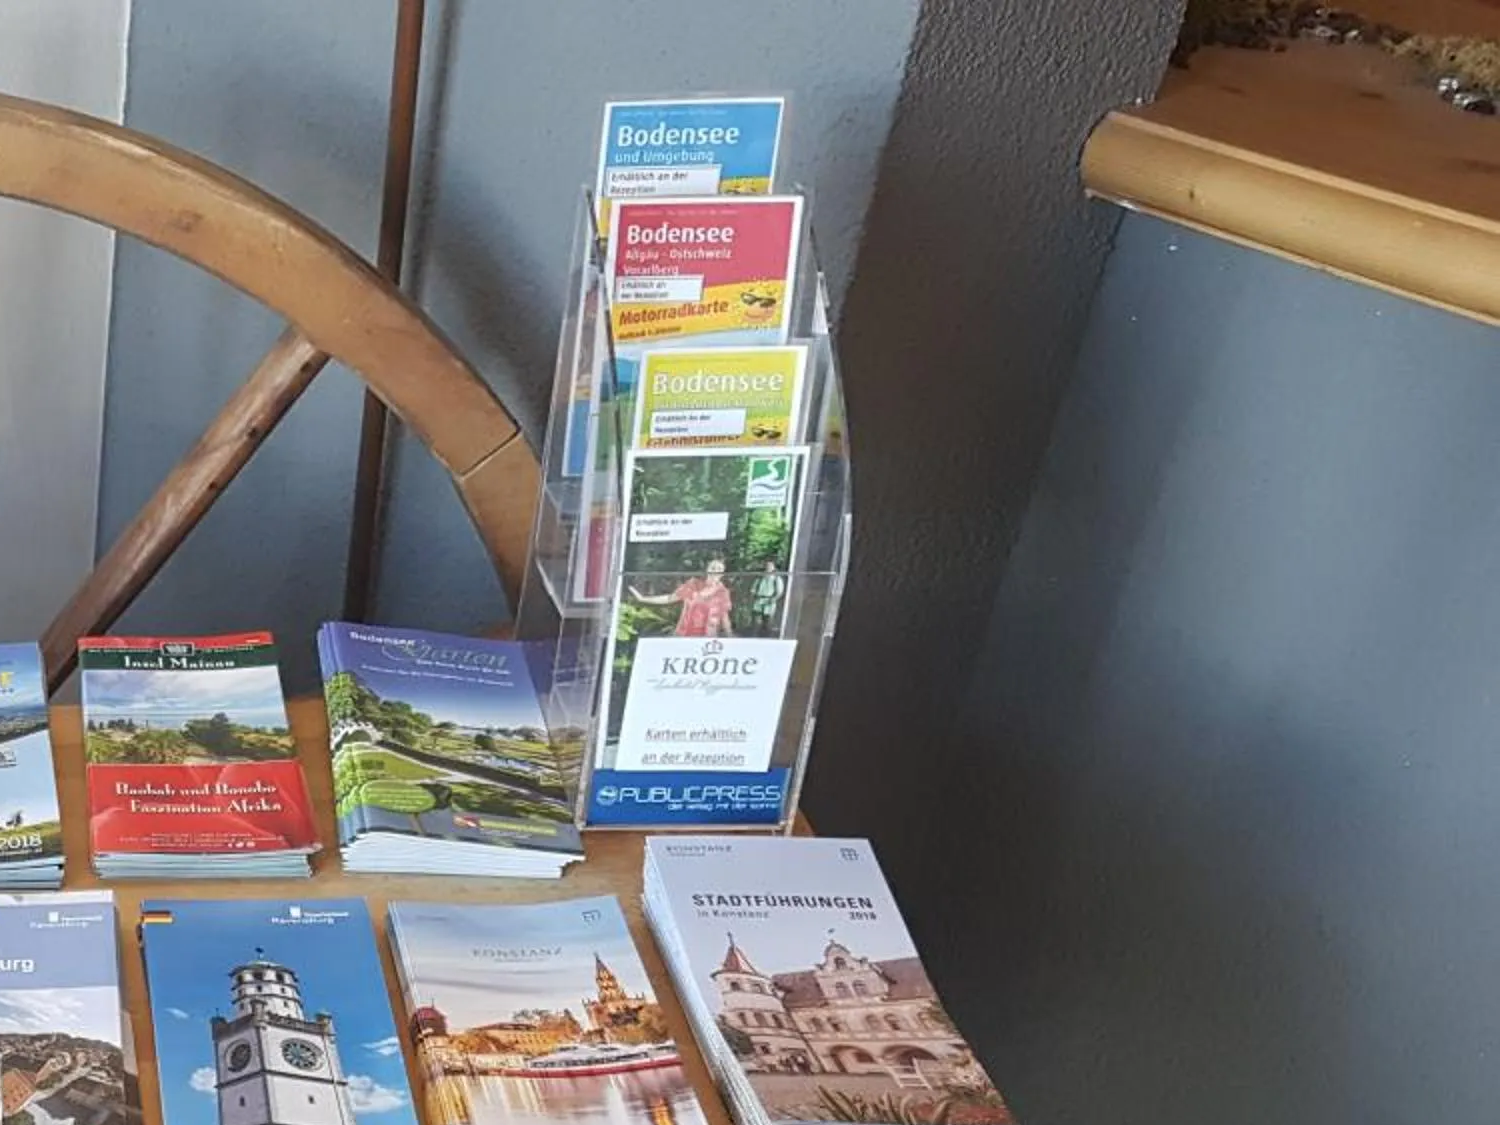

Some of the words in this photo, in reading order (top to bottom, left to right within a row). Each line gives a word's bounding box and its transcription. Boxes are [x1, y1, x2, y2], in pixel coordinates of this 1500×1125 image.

[617, 121, 741, 146] Bodensee
[615, 152, 639, 163] und
[643, 150, 715, 165] Umgebung
[627, 222, 734, 245] Bodensee
[619, 299, 730, 327] Motorradkarte
[653, 370, 785, 395] Bodensee
[123, 655, 164, 670] Insel
[644, 728, 687, 741] Karten
[640, 753, 658, 765] an
[659, 751, 681, 765] der
[619, 785, 781, 804] PUBLICPRESS
[226, 797, 282, 814] Afrika
[691, 891, 874, 910] STADTFÜHRUNGEN
